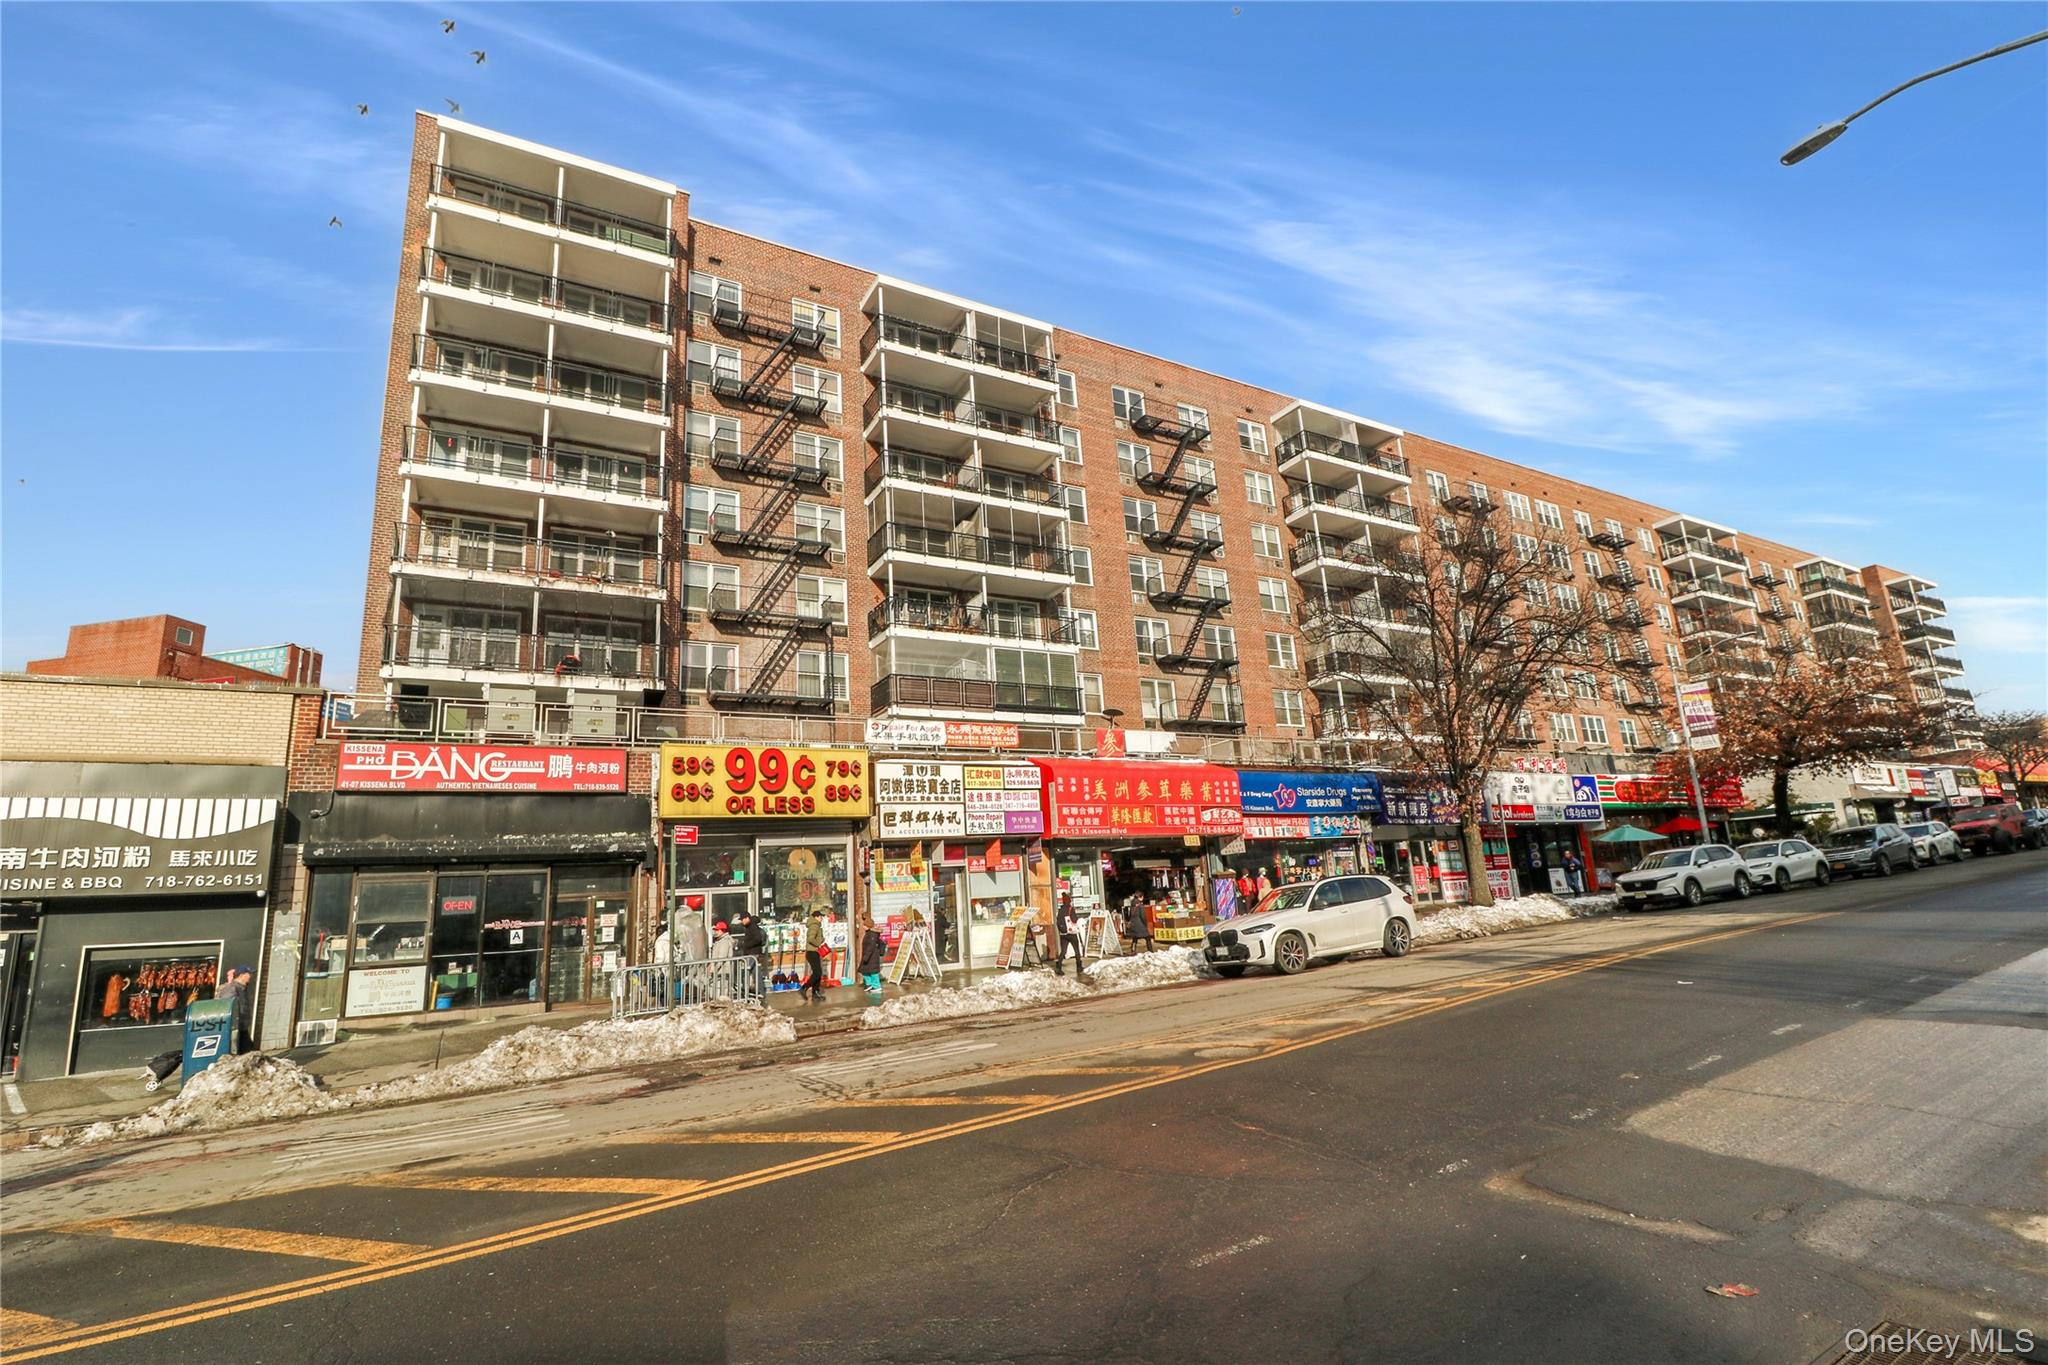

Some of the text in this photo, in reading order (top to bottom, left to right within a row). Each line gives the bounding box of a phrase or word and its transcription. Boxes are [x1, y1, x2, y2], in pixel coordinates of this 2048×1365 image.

[346, 745, 383, 753] KISSENA
[491, 760, 544, 769] RESTAURANT
[672, 757, 715, 776] 59¢
[725, 747, 816, 794] 99¢
[826, 760, 861, 778] 79¢
[360, 781, 388, 789] KISSENA
[671, 783, 714, 802] 69¢
[825, 784, 862, 803] 89¢
[1297, 787, 1347, 798] Starside Drugs
[726, 796, 816, 814] OR LESS
[968, 813, 1003, 822] Phone Repair
[0, 846, 258, 870] 南牛肉河粉 馬來小吃
[0, 874, 263, 891] ISINE & BBQ 718-762-6151
[443, 901, 475, 912] OPEN
[512, 931, 521, 941] A
